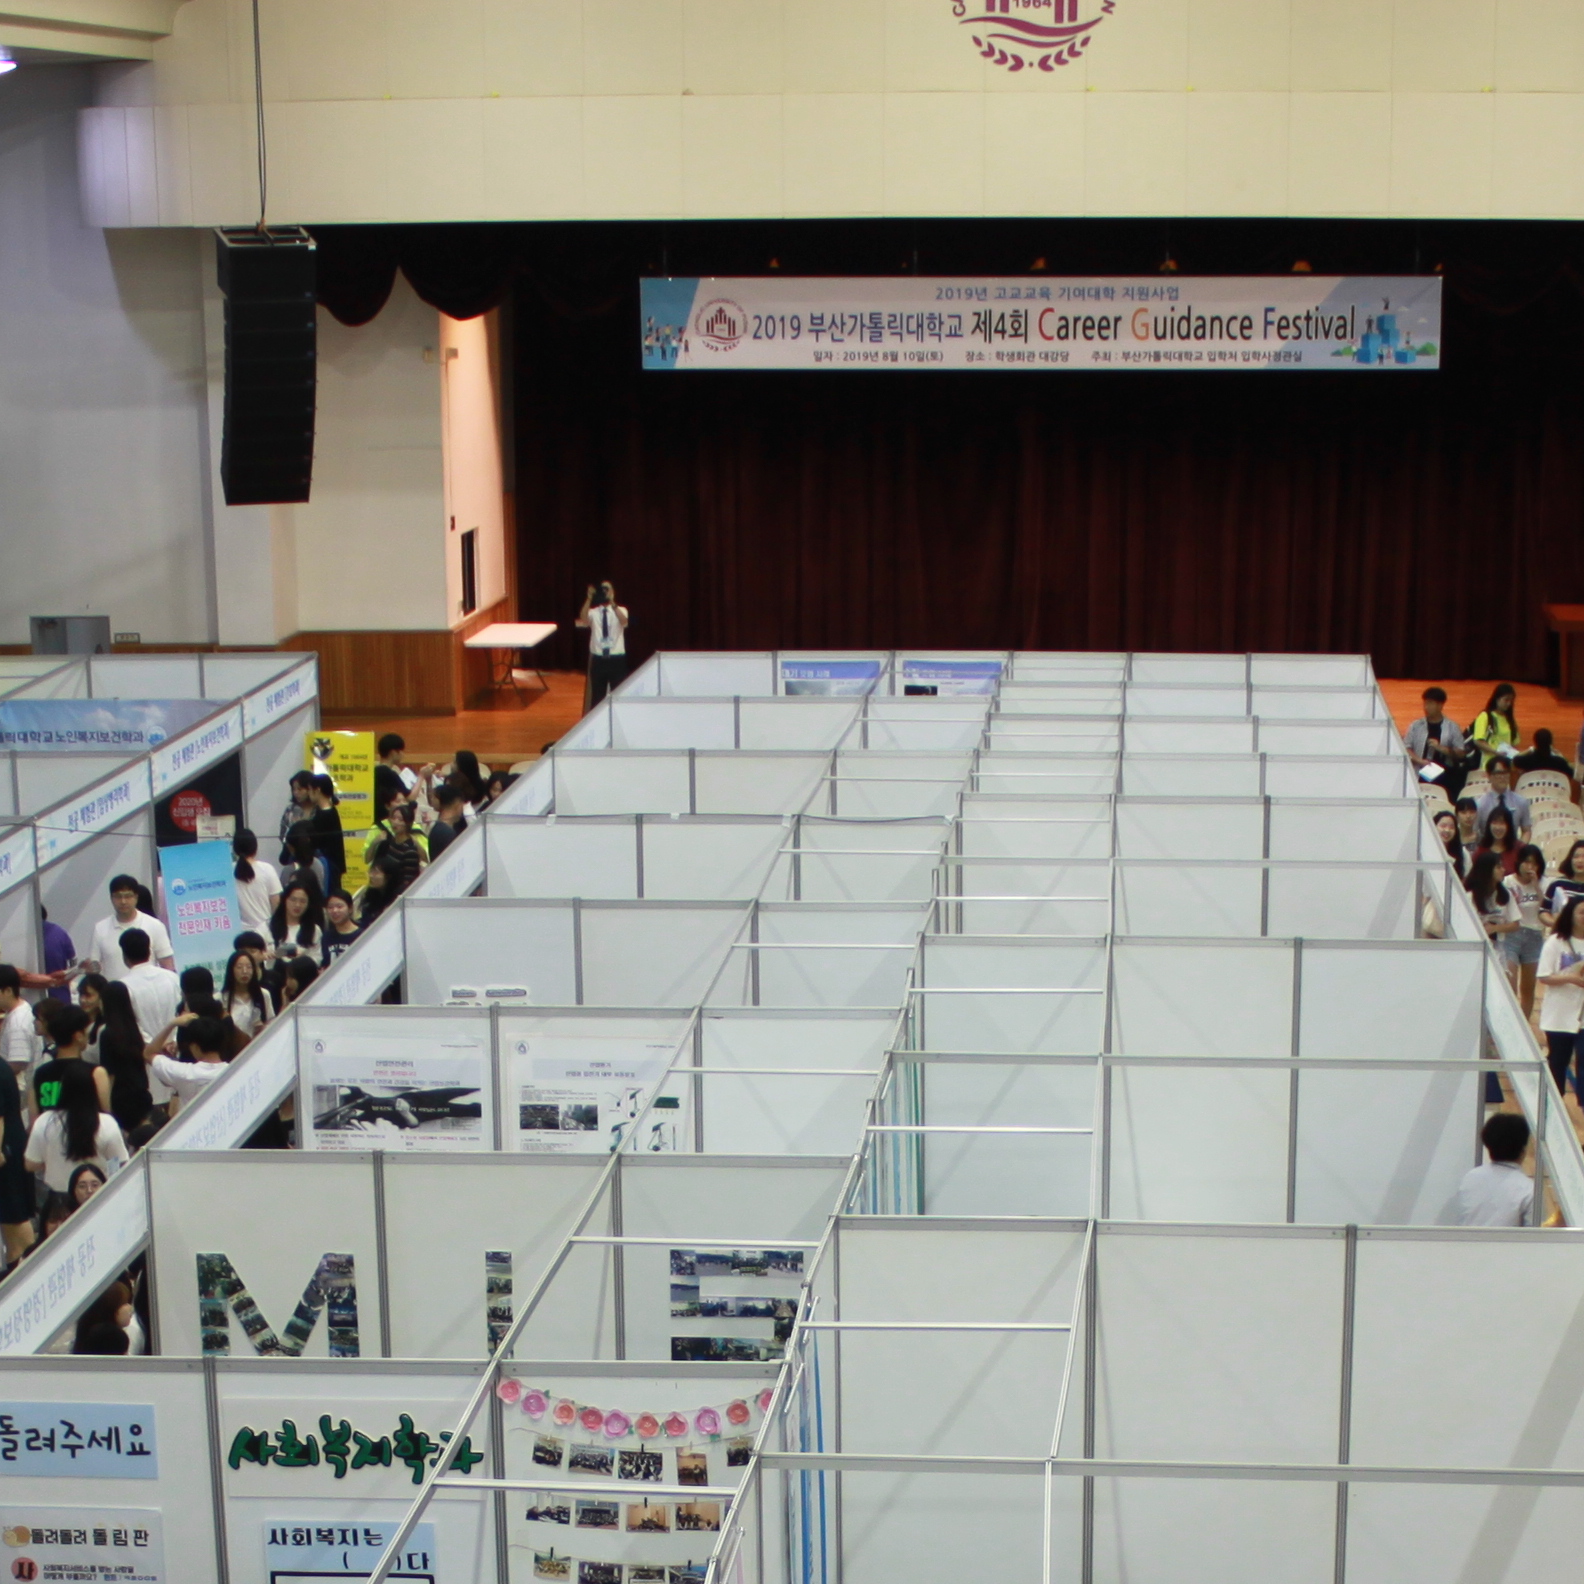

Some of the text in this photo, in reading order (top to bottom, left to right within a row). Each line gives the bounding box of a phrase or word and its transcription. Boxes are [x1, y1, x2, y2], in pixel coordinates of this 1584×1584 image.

[936, 286, 1180, 301] 2019년 고교교육 기여대학 지원사업
[753, 315, 801, 340] 2019
[808, 312, 963, 344] 부산가톨릭대학교
[971, 309, 1029, 344] 제4회
[1038, 308, 1122, 341] Career
[1131, 306, 1253, 341] Guidance
[1263, 305, 1355, 341] Festival
[842, 351, 879, 363] 2019년
[883, 351, 899, 363] 8월
[995, 351, 1034, 363] 학생회관
[1038, 351, 1070, 363] 대강당
[1121, 351, 1204, 363] 부산가톨릭대학교
[1206, 351, 1237, 363] 입학처
[1241, 351, 1303, 363] 입학사정관실
[54, 730, 144, 744] 노인복지보건학과
[176, 899, 228, 917] 노인복지보건
[178, 919, 211, 935] 전문인재
[228, 1413, 484, 1484] 사회복지학과
[31, 1528, 87, 1544] 돌려돌려
[268, 1528, 383, 1546] 사회복지는
[14, 1562, 34, 1580] 사
